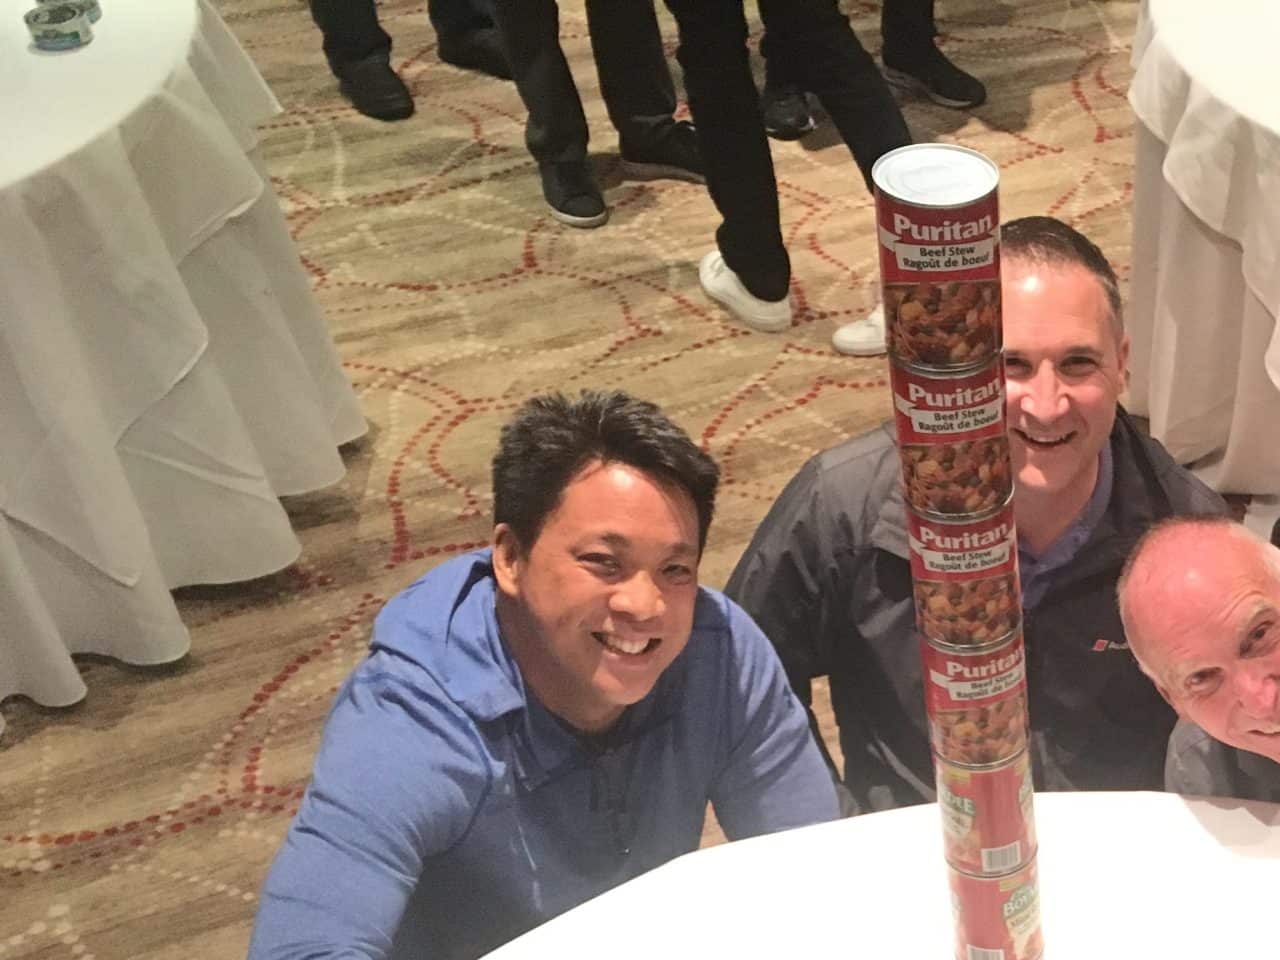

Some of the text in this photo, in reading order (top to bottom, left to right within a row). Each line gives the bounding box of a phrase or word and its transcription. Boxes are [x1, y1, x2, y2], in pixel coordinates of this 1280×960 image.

[893, 212, 992, 241] Puritan
[919, 245, 976, 257] Beef Stew
[902, 257, 941, 271] Ragoût
[944, 257, 959, 268] de
[908, 377, 1001, 407] Puritan
[933, 407, 985, 421] Beef Stew
[918, 421, 955, 433] Ragoût
[957, 420, 971, 431] de
[919, 523, 1008, 549] Puritan
[942, 549, 993, 562] Beef Stew
